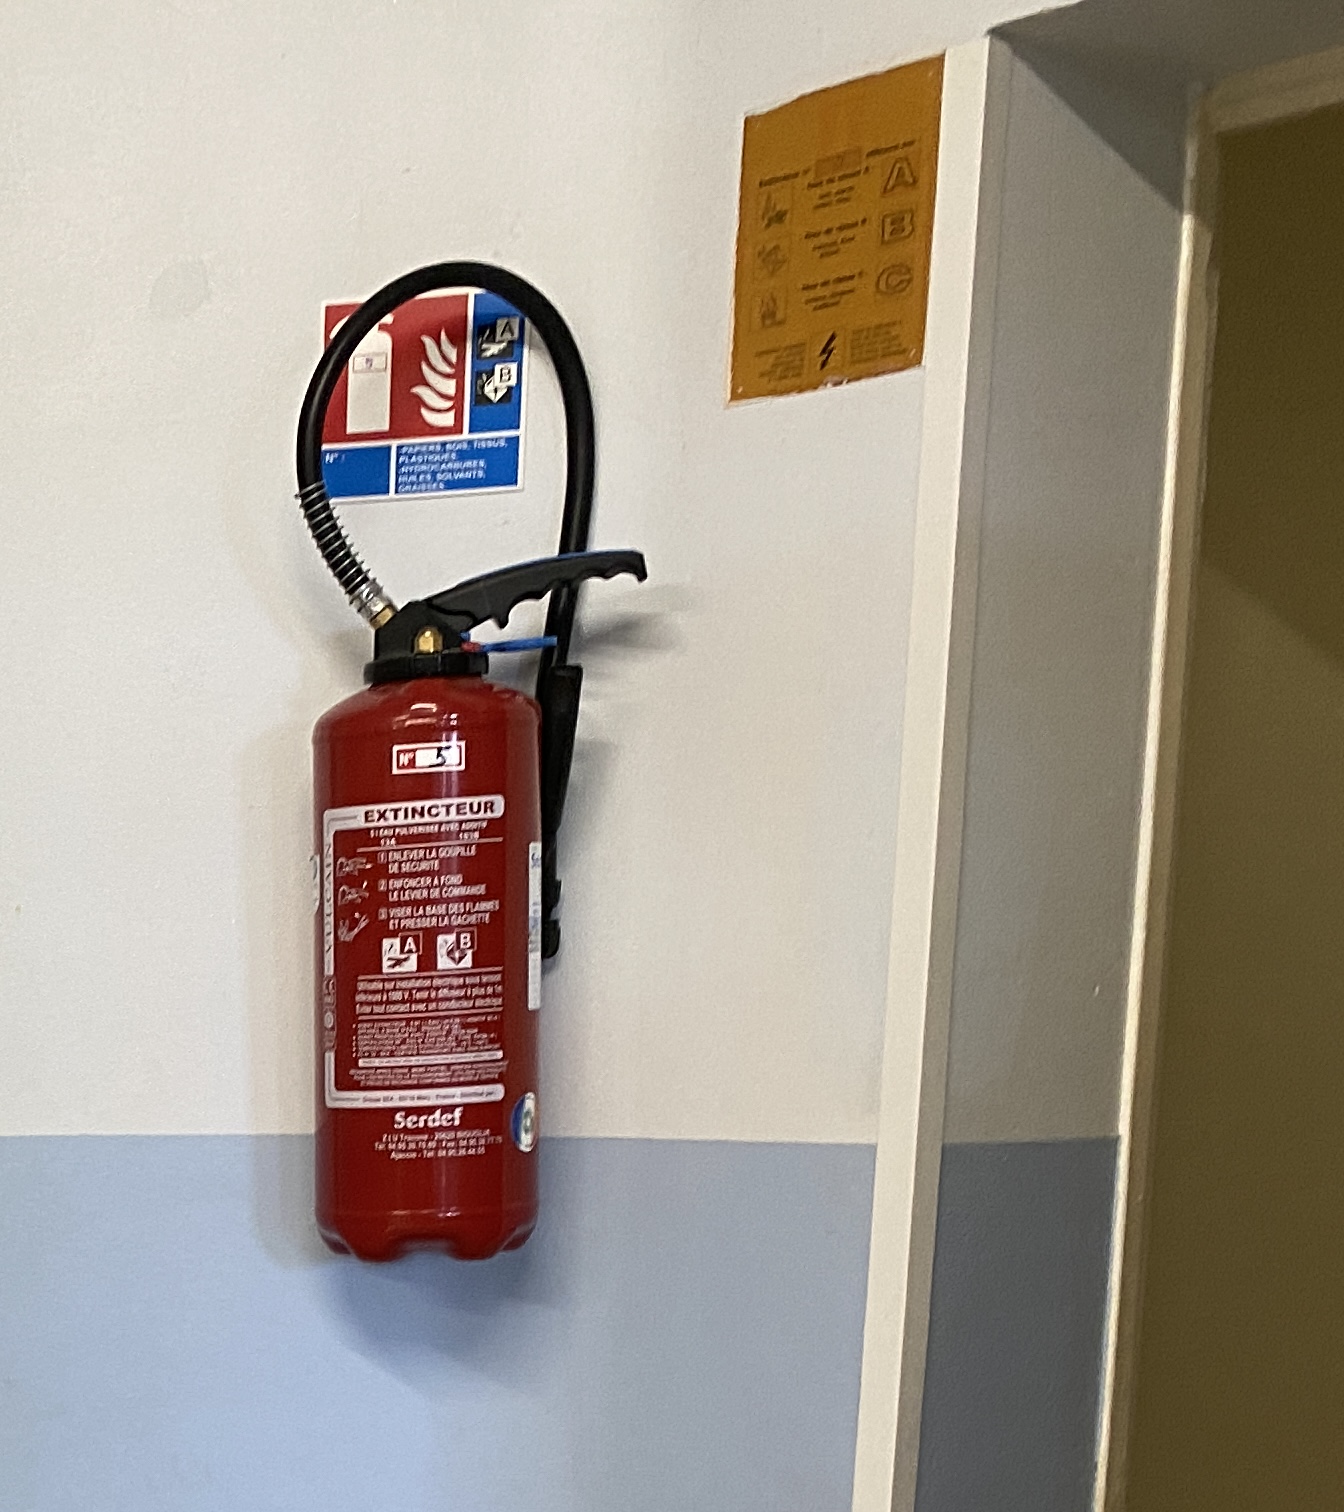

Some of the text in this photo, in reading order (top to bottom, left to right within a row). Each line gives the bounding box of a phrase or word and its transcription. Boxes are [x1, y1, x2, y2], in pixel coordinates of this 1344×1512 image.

[880, 156, 918, 198] A
[881, 209, 915, 245] B
[500, 320, 514, 338] A
[500, 366, 512, 383] B
[428, 745, 452, 768] 5
[363, 800, 496, 824] EXTINCTEUR
[403, 937, 418, 953] A
[458, 932, 472, 949] B
[393, 1106, 464, 1130] Serdef
